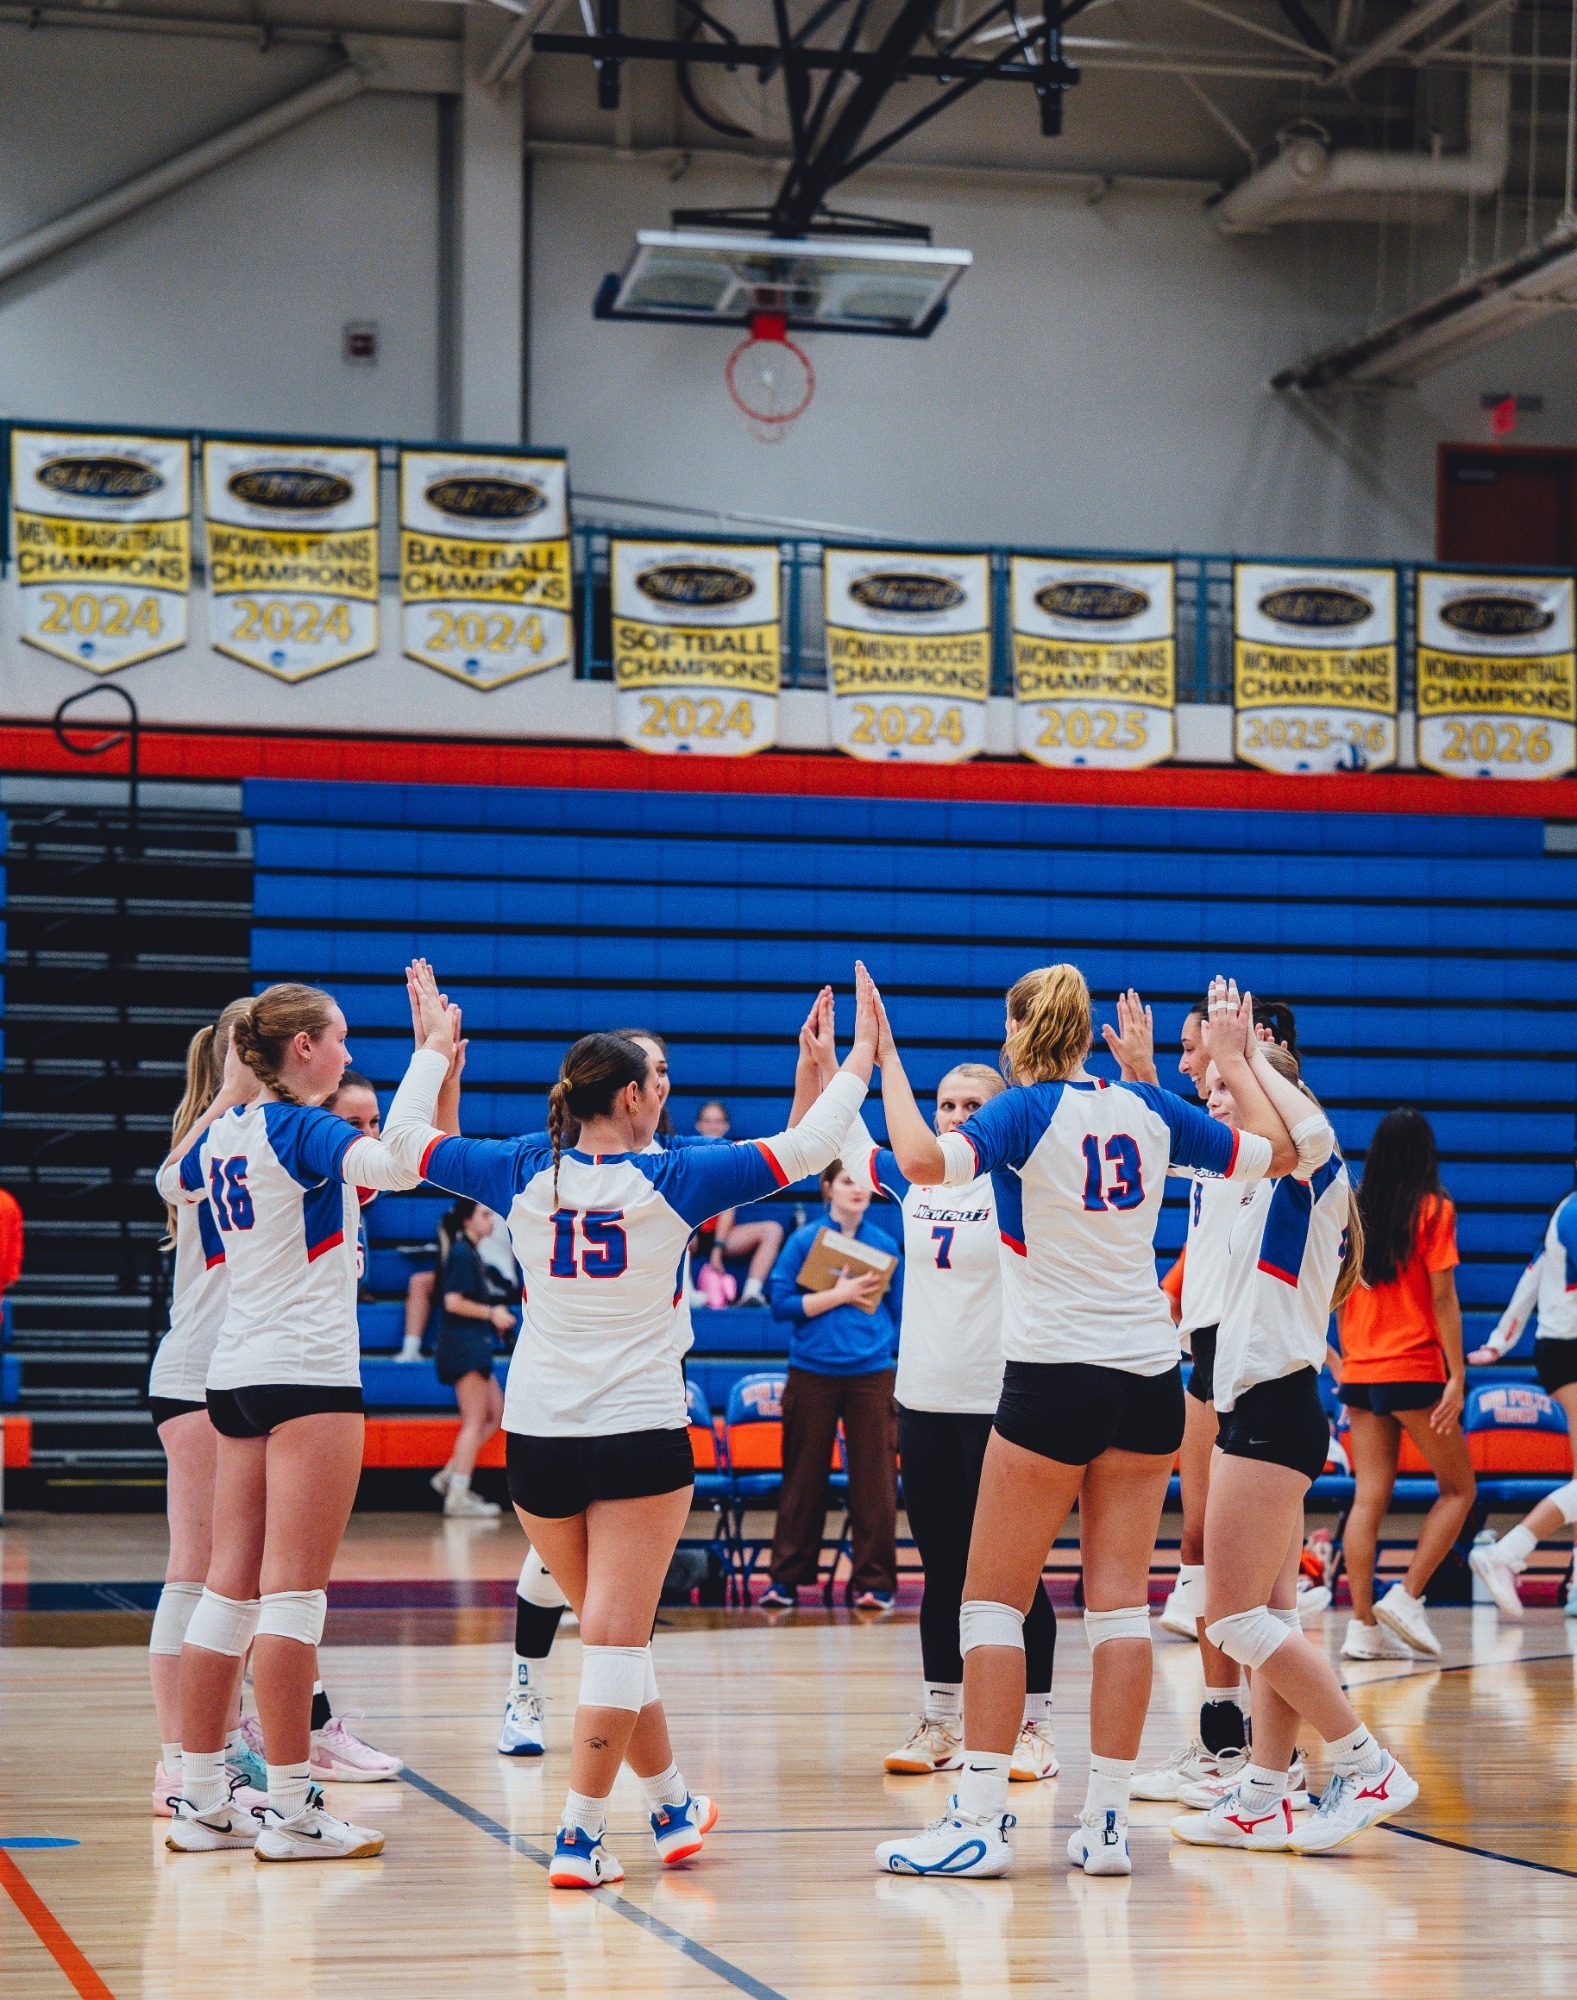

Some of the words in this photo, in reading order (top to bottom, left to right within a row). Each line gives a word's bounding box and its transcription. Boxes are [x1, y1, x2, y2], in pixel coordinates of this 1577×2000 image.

[18, 551, 184, 581] CHAMPIONS
[407, 540, 562, 573] BASEBALL
[212, 561, 372, 590] CHAMPIONS
[404, 570, 565, 601] CHAMPIONS
[40, 592, 163, 637] 2024
[232, 600, 351, 643] 2024
[426, 610, 545, 654] 2024
[619, 626, 772, 656] SOFTBALL
[617, 657, 775, 683] CHAMPIONS
[832, 663, 984, 692] CHAMPIONS
[1016, 670, 1168, 698] CHAMPIONS
[1240, 677, 1391, 704] CHAMPIONS
[1422, 684, 1571, 711] CHAMPIONS
[639, 695, 755, 738] 2024
[851, 705, 964, 746] 2024
[1037, 708, 1148, 750] 2025
[1246, 718, 1386, 752] 2025-26
[1442, 722, 1552, 763] 2026
[1082, 1133, 1146, 1212] 13
[209, 1155, 256, 1232] 16
[549, 1208, 628, 1279] 15
[931, 1226, 955, 1269] 7
